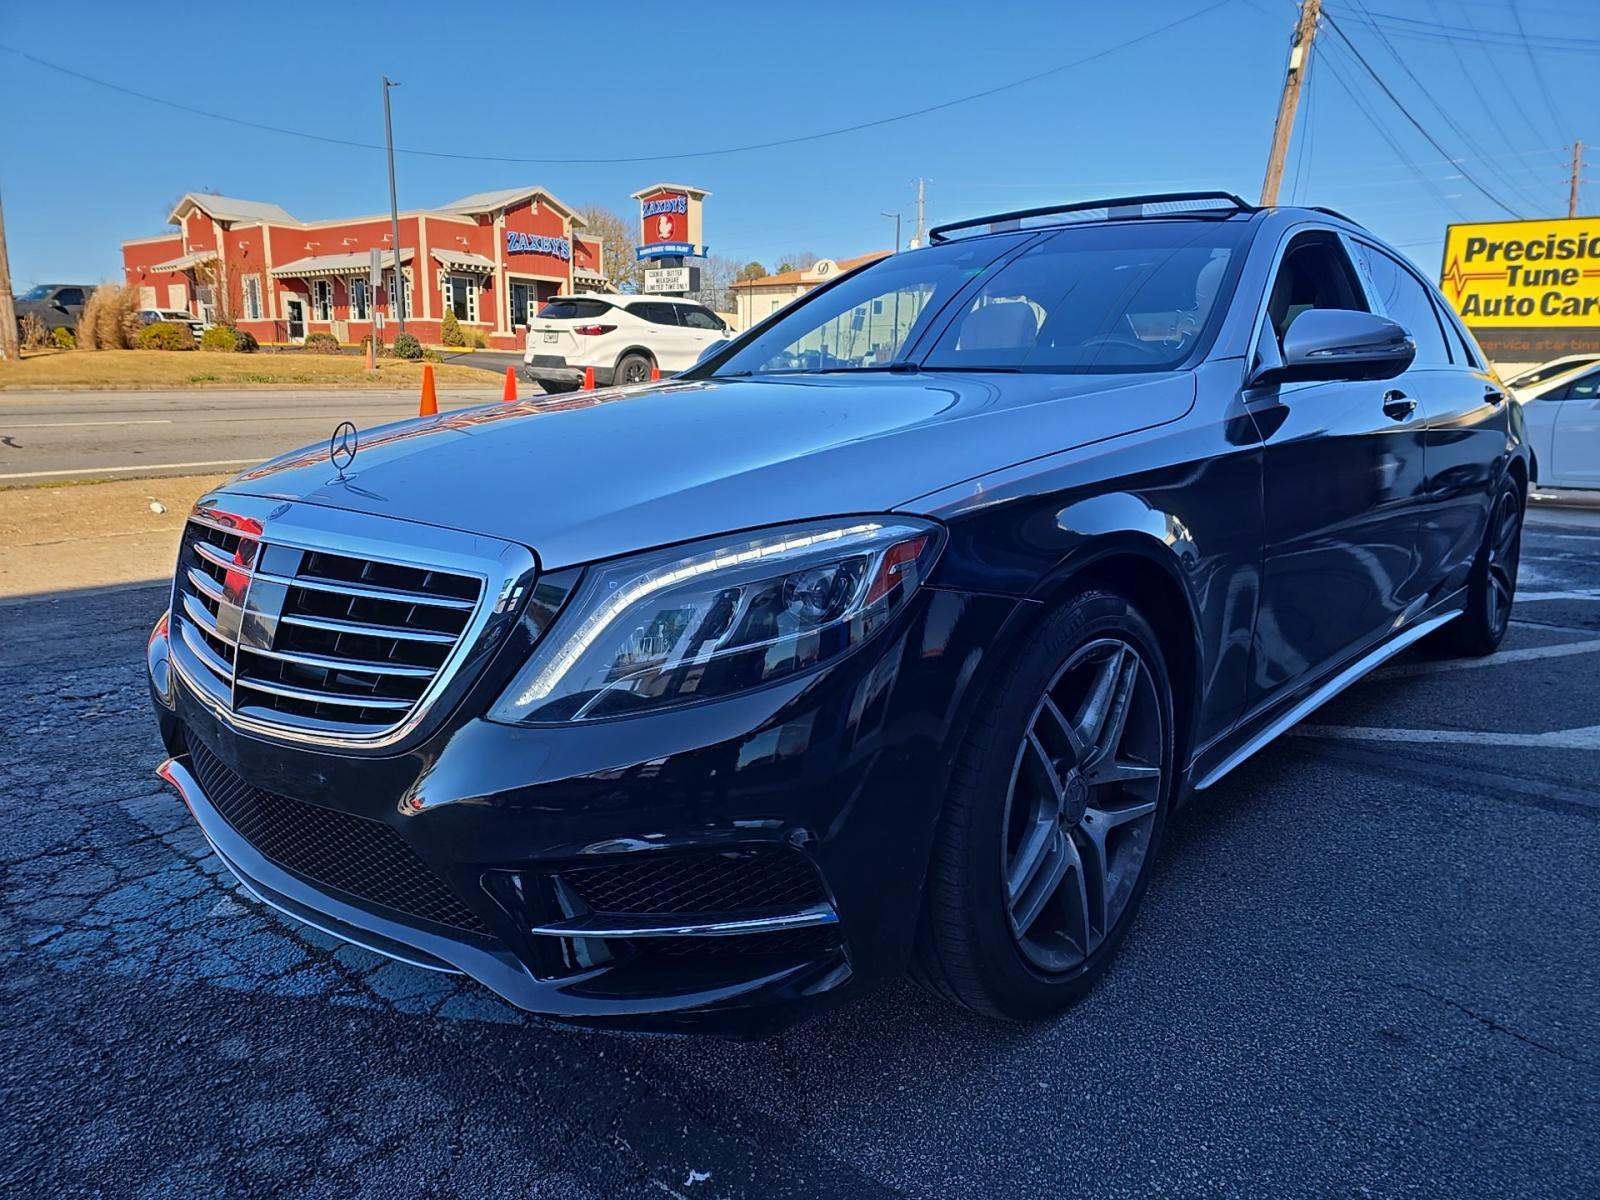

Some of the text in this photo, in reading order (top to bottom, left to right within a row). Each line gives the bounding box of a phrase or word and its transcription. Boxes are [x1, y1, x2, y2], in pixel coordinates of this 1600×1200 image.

[643, 195, 688, 217] ZAXBY'S
[507, 231, 571, 260] ZAXBY'S
[1506, 265, 1579, 287] Tune
[1460, 292, 1600, 317] Auto Car
